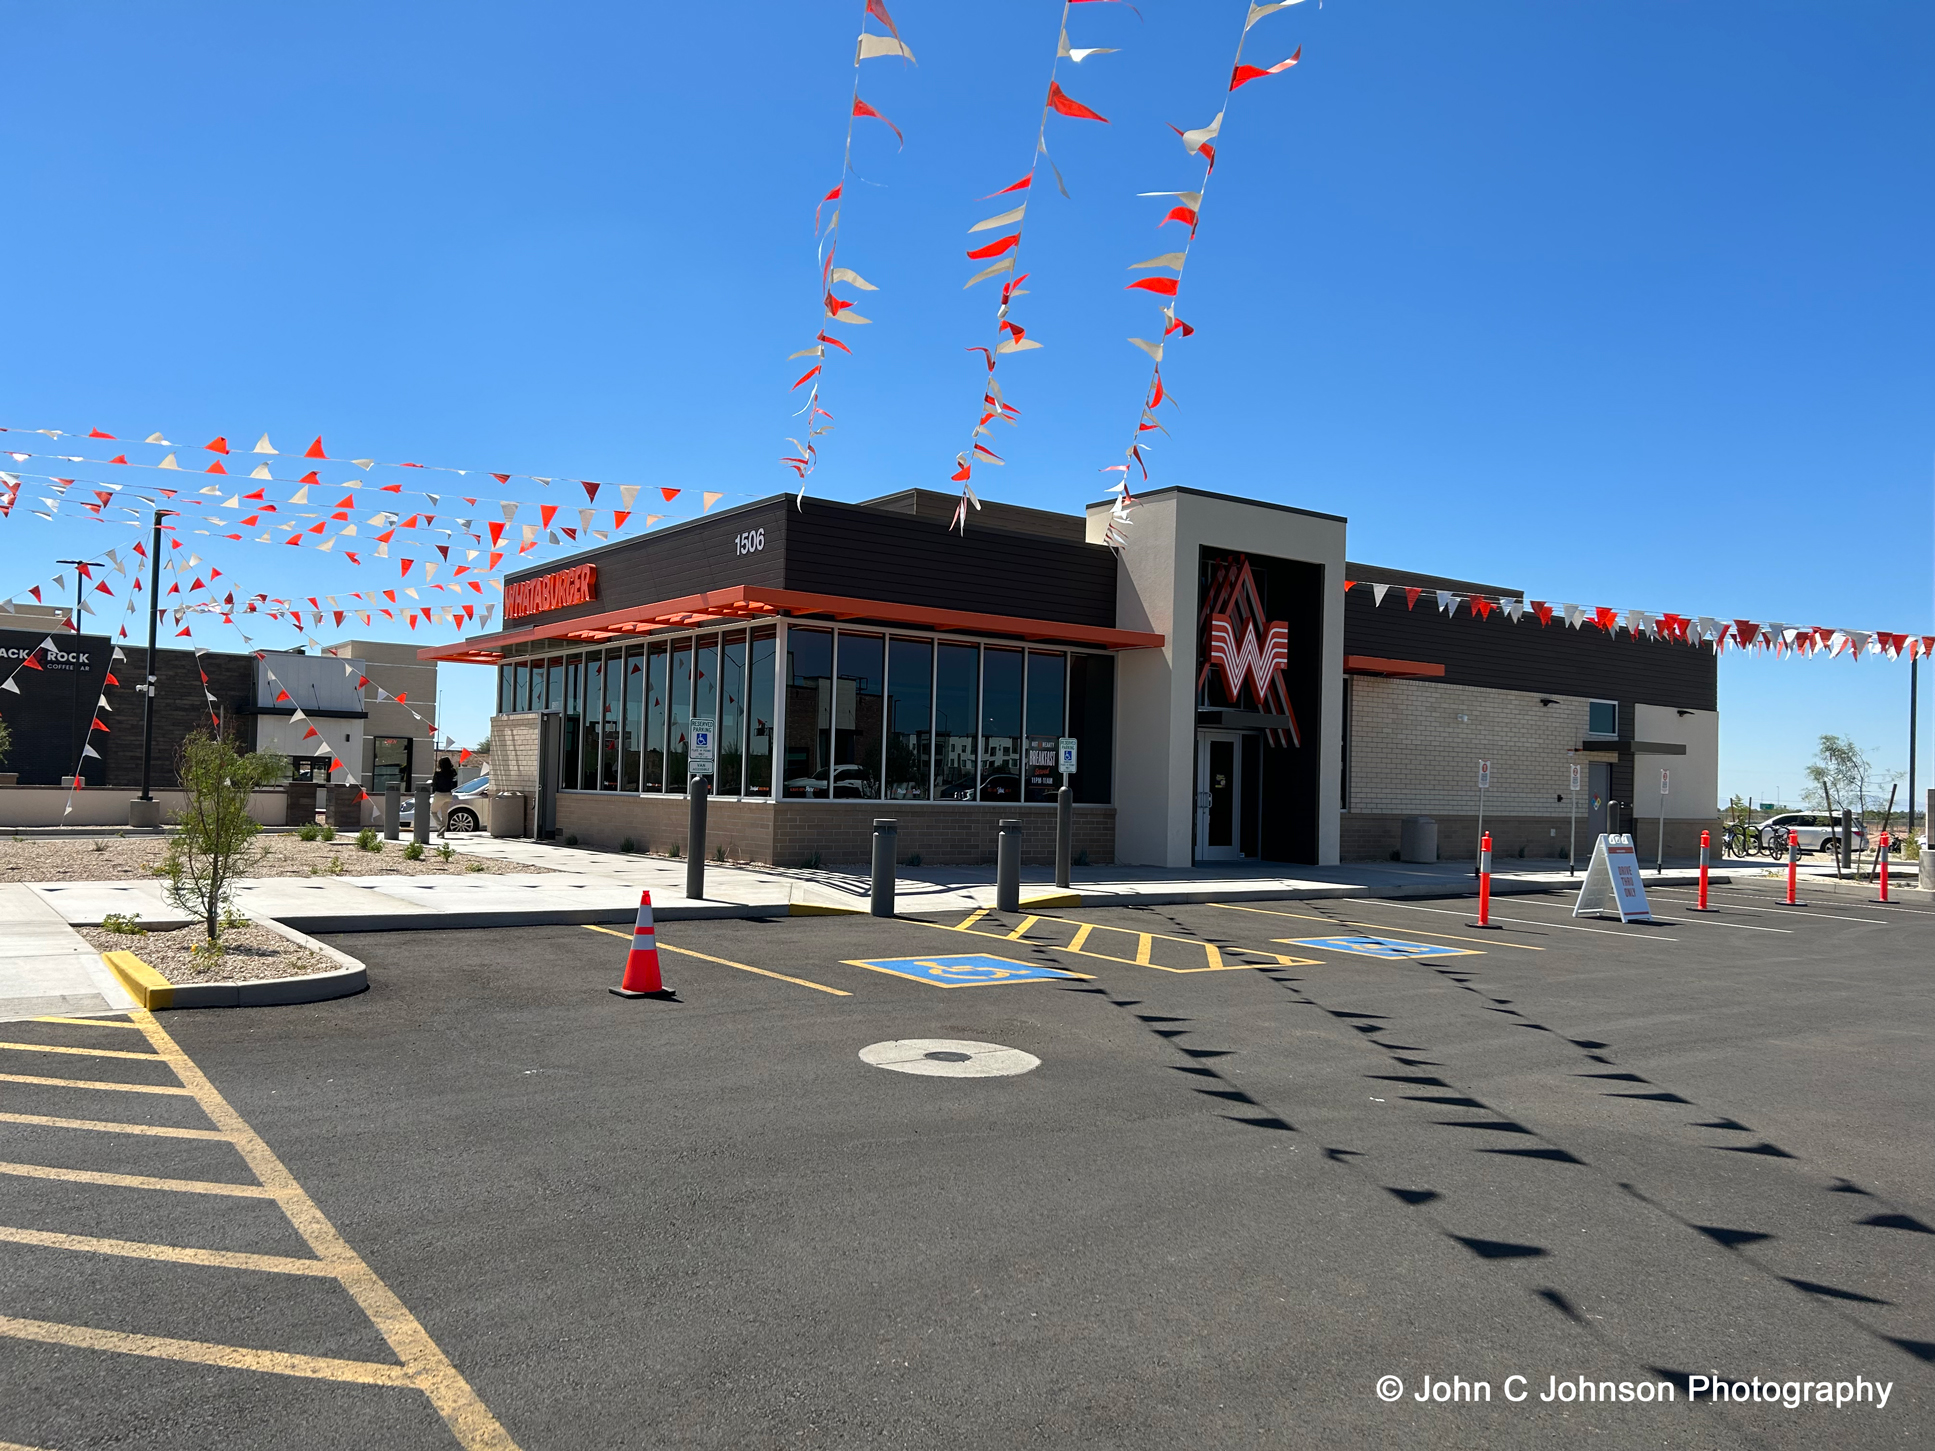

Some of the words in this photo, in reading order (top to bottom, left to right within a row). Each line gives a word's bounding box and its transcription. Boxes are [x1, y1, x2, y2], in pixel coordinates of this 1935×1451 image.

[734, 528, 765, 556] 1506
[503, 564, 597, 620] WHATABURGER
[47, 652, 90, 663] ROCK
[1030, 750, 1056, 766] BREAKFAST
[1621, 877, 1634, 886] THRU
[1624, 888, 1636, 897] ONLY
